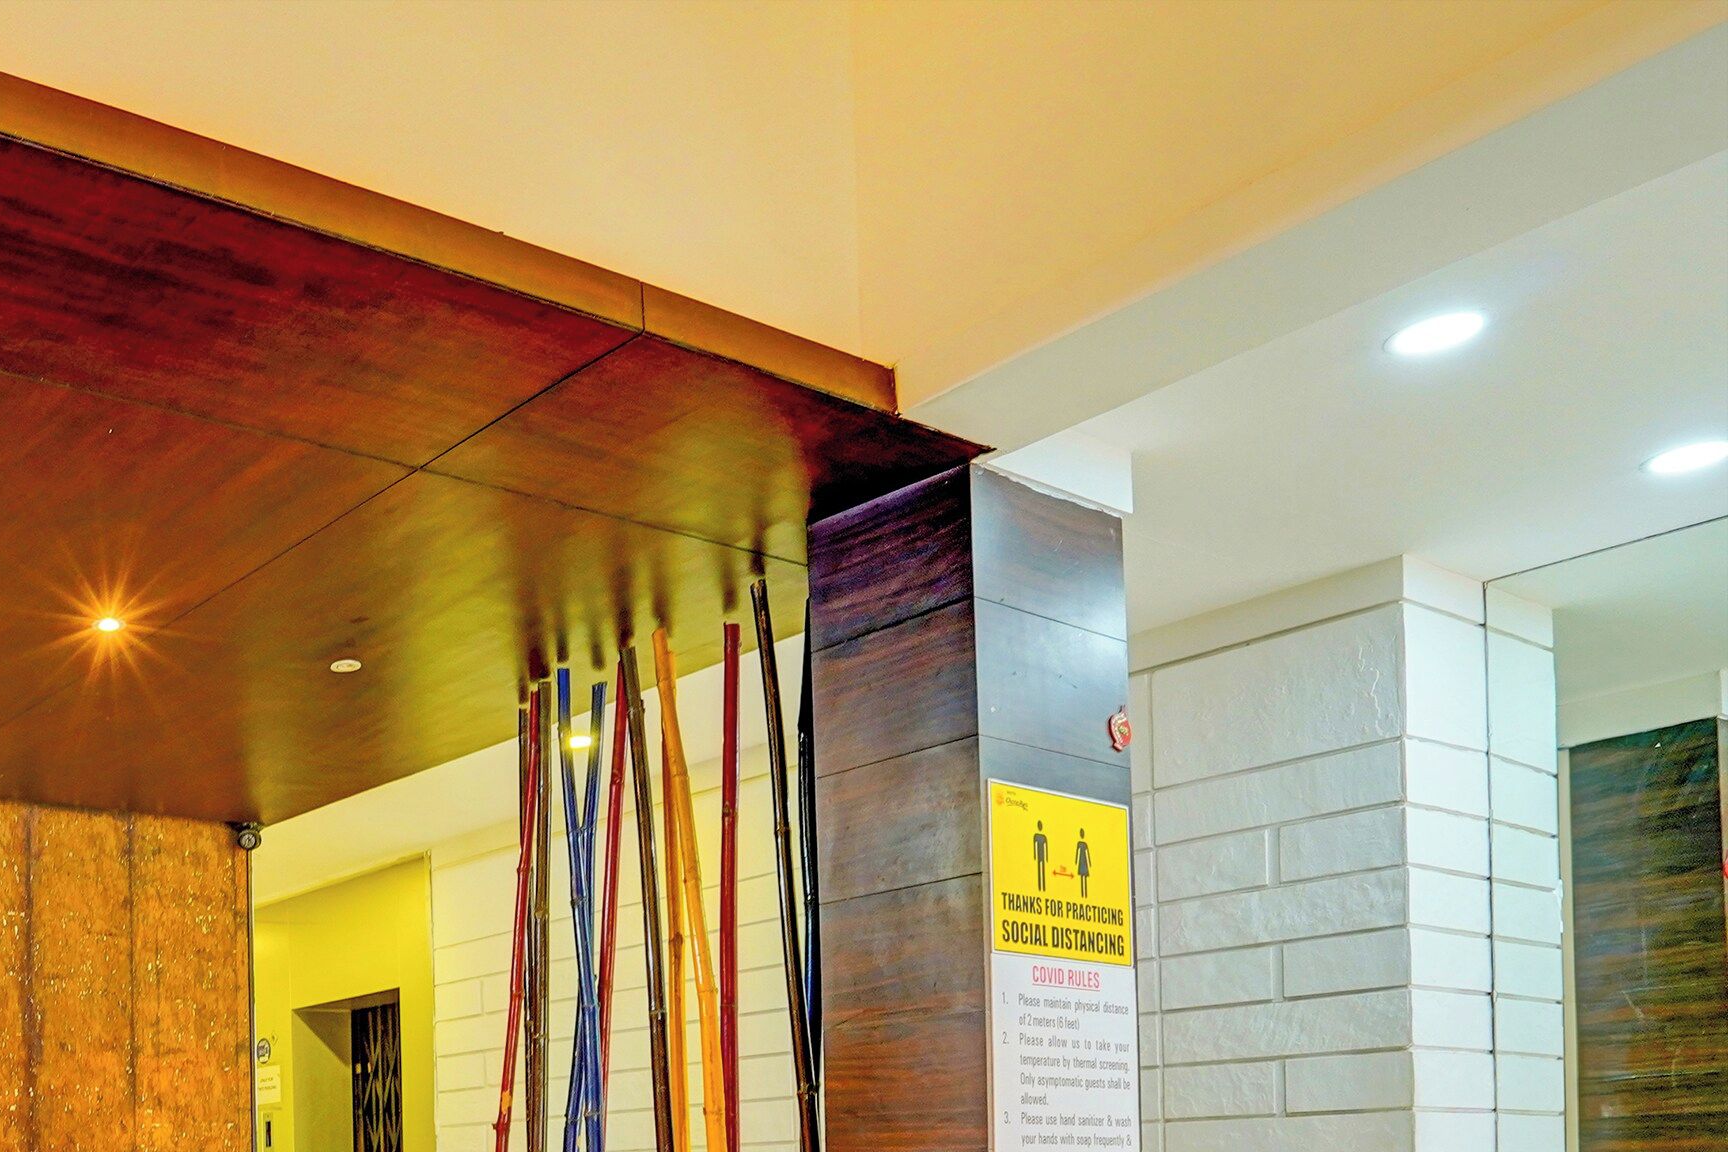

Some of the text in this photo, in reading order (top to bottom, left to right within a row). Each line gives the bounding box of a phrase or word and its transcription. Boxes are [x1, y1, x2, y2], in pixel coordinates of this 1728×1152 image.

[1001, 892, 1123, 926] THANKS FOR PRACTICING
[1002, 920, 1124, 957] SOCIAL DISTANCING
[1032, 966, 1100, 988] COVID RULES
[1019, 993, 1128, 1015] Please maintain physical distance
[1033, 1016, 1080, 1031] meters feet)
[1020, 1033, 1129, 1053] Please allow us to take your
[1020, 1054, 1060, 1068] temperature
[1063, 1057, 1070, 1069] by
[1073, 1056, 1097, 1069] thermal
[1020, 1072, 1130, 1091] Only asymptomatic guests shall be
[1021, 1093, 1048, 1105] allowed.
[1021, 1112, 1131, 1127] Please use hand sanitizer & wash
[1022, 1133, 1131, 1148] your hands with soap frequently &
